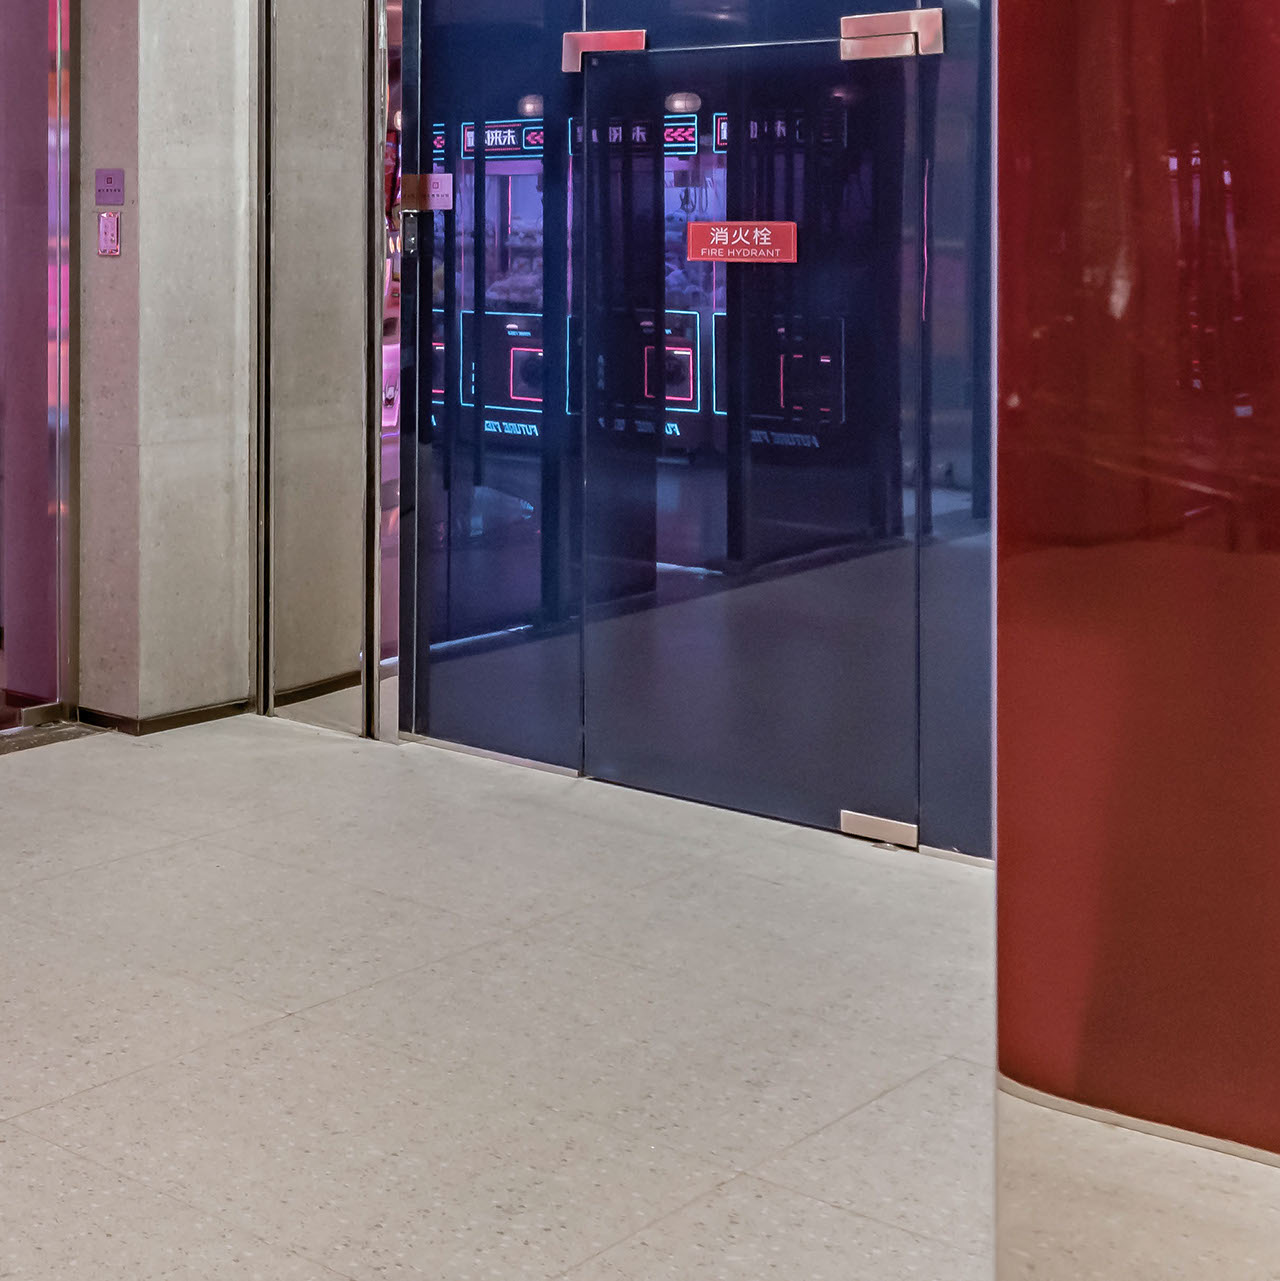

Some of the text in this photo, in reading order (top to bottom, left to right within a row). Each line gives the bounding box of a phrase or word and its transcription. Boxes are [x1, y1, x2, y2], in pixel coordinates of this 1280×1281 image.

[709, 227, 772, 246] 消火栓
[700, 248, 781, 258] FIRE HYDRANT
